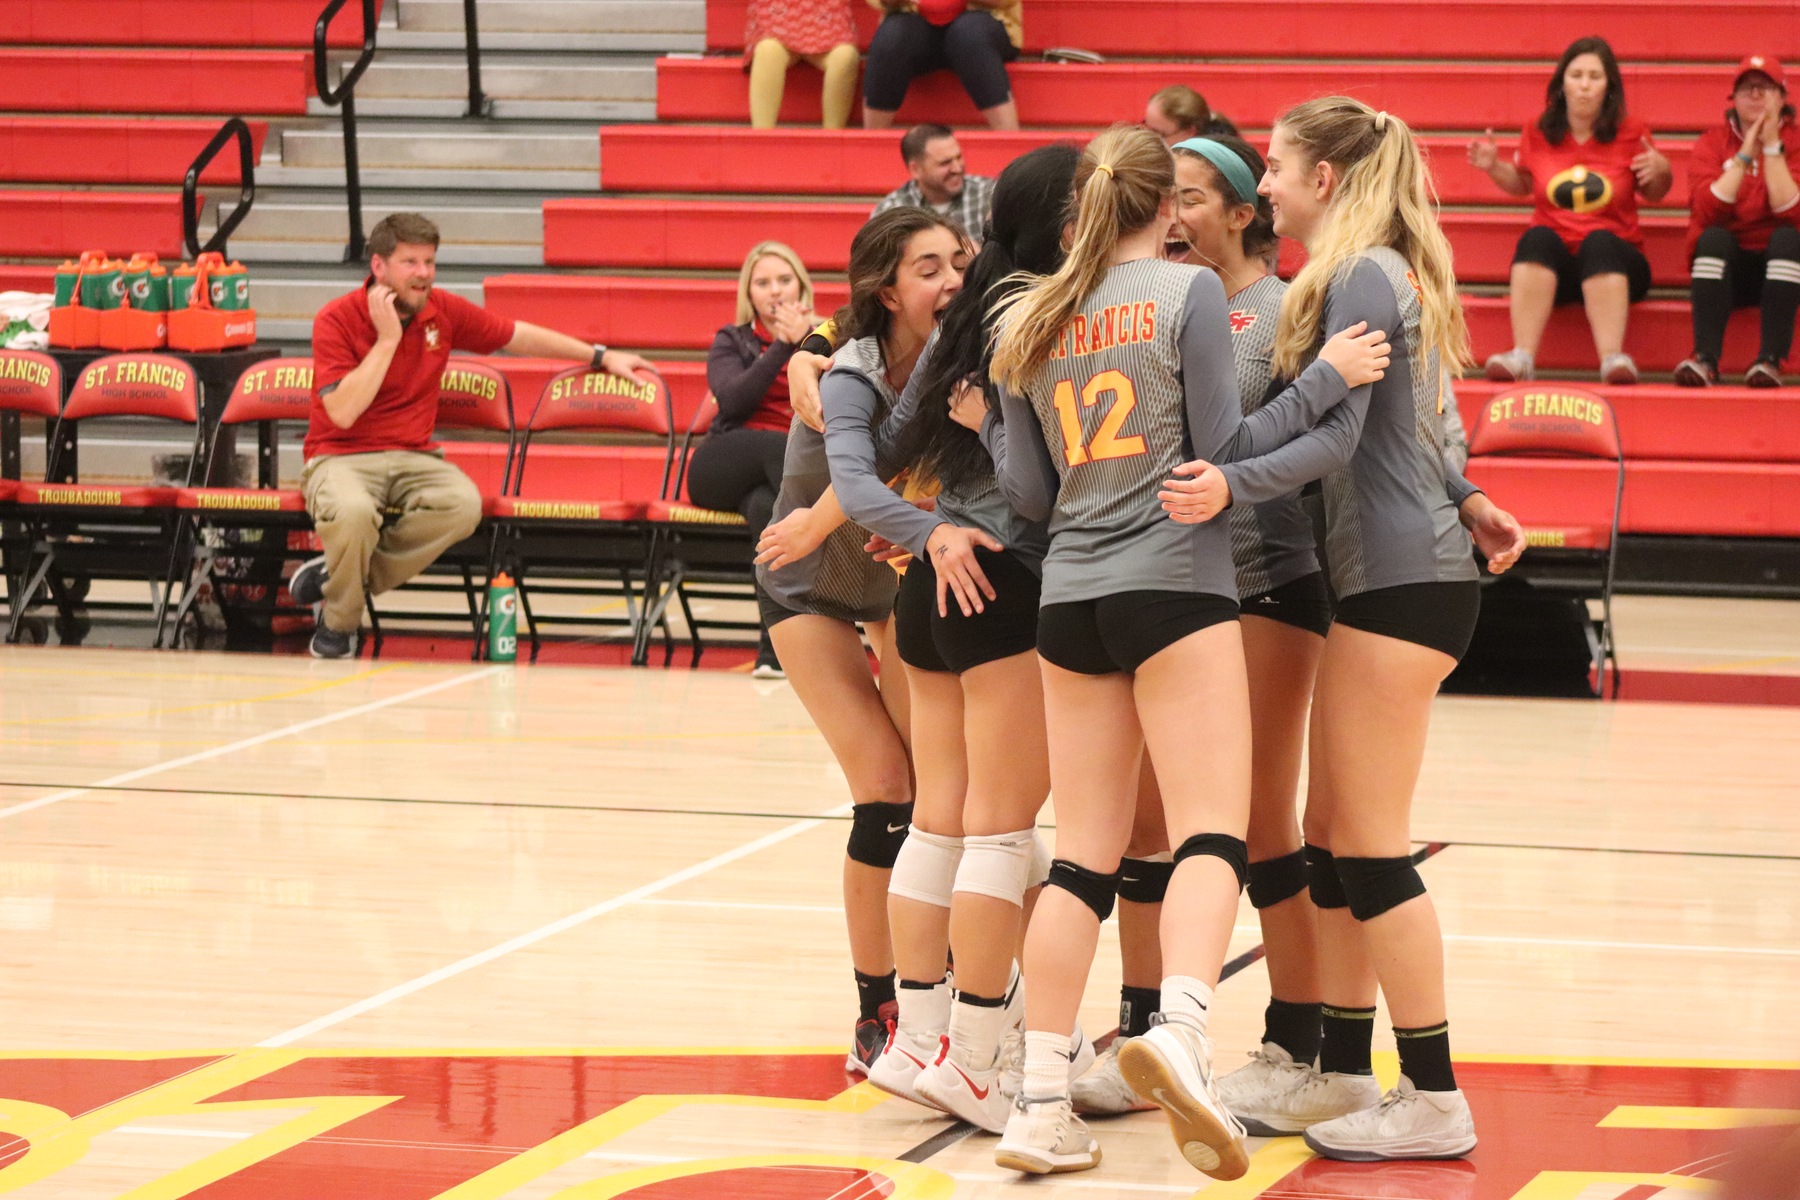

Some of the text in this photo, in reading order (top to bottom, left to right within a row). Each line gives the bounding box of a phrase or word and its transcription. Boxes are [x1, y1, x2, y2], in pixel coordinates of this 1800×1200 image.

[84, 361, 187, 392] ST. FRANCIS
[243, 369, 269, 395] ST.
[551, 372, 657, 405] ST. FRANCIS
[129, 389, 168, 400] SCHOOL
[1053, 368, 1149, 468] 12
[1490, 393, 1602, 425] ST. FRANCIS
[37, 488, 122, 506] TROUBADOURS
[196, 493, 281, 511] TROUBADOURS
[512, 501, 600, 519] TROUBADOURS
